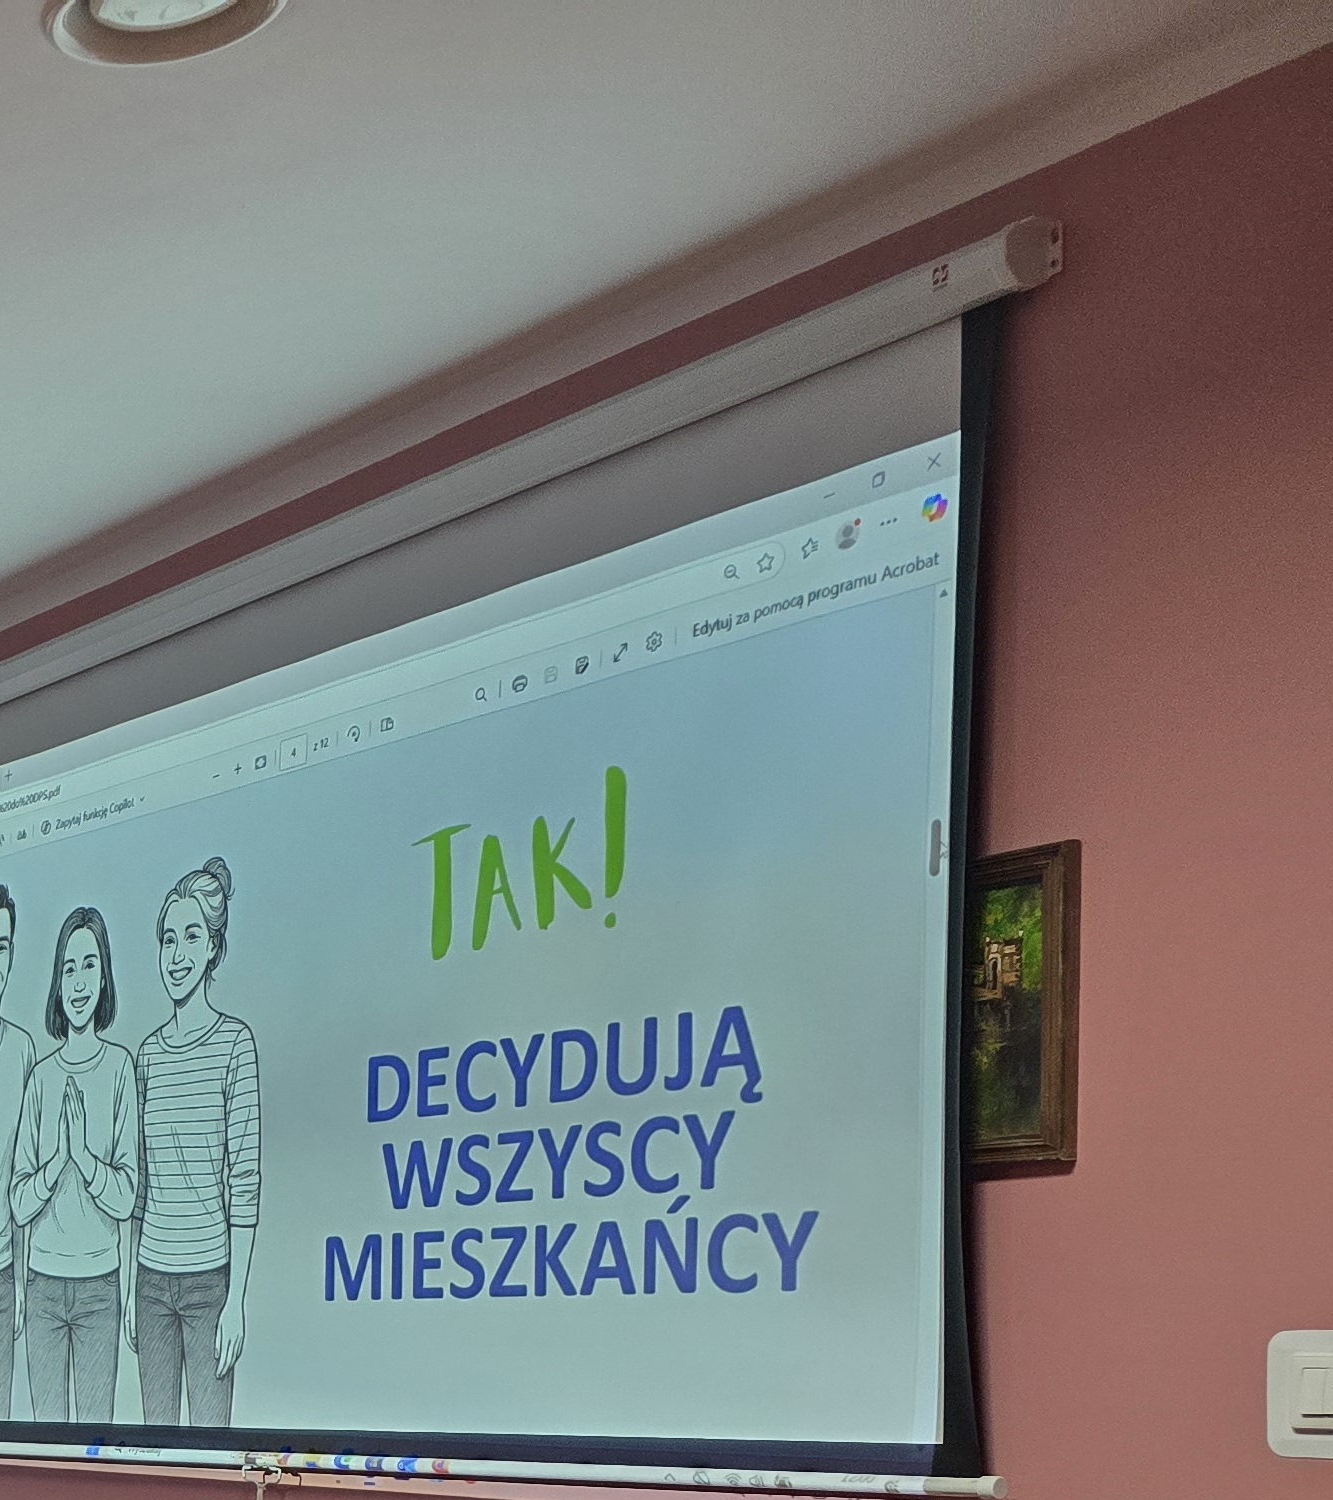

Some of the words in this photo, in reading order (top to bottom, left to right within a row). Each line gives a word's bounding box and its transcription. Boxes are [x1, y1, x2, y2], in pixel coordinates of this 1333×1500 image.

[692, 613, 733, 638] Edytuj
[735, 612, 751, 626] za
[753, 595, 805, 623] pomocą
[807, 573, 877, 607] programu
[880, 551, 940, 582] Acrobat
[319, 737, 330, 750] 12
[55, 811, 81, 831] Zapytaj
[411, 765, 627, 960] TAK!
[366, 1005, 763, 1123] DECYDUJĄ
[382, 1110, 735, 1210] WSZYSCY
[324, 1195, 819, 1301] MIESZKAŃCY
